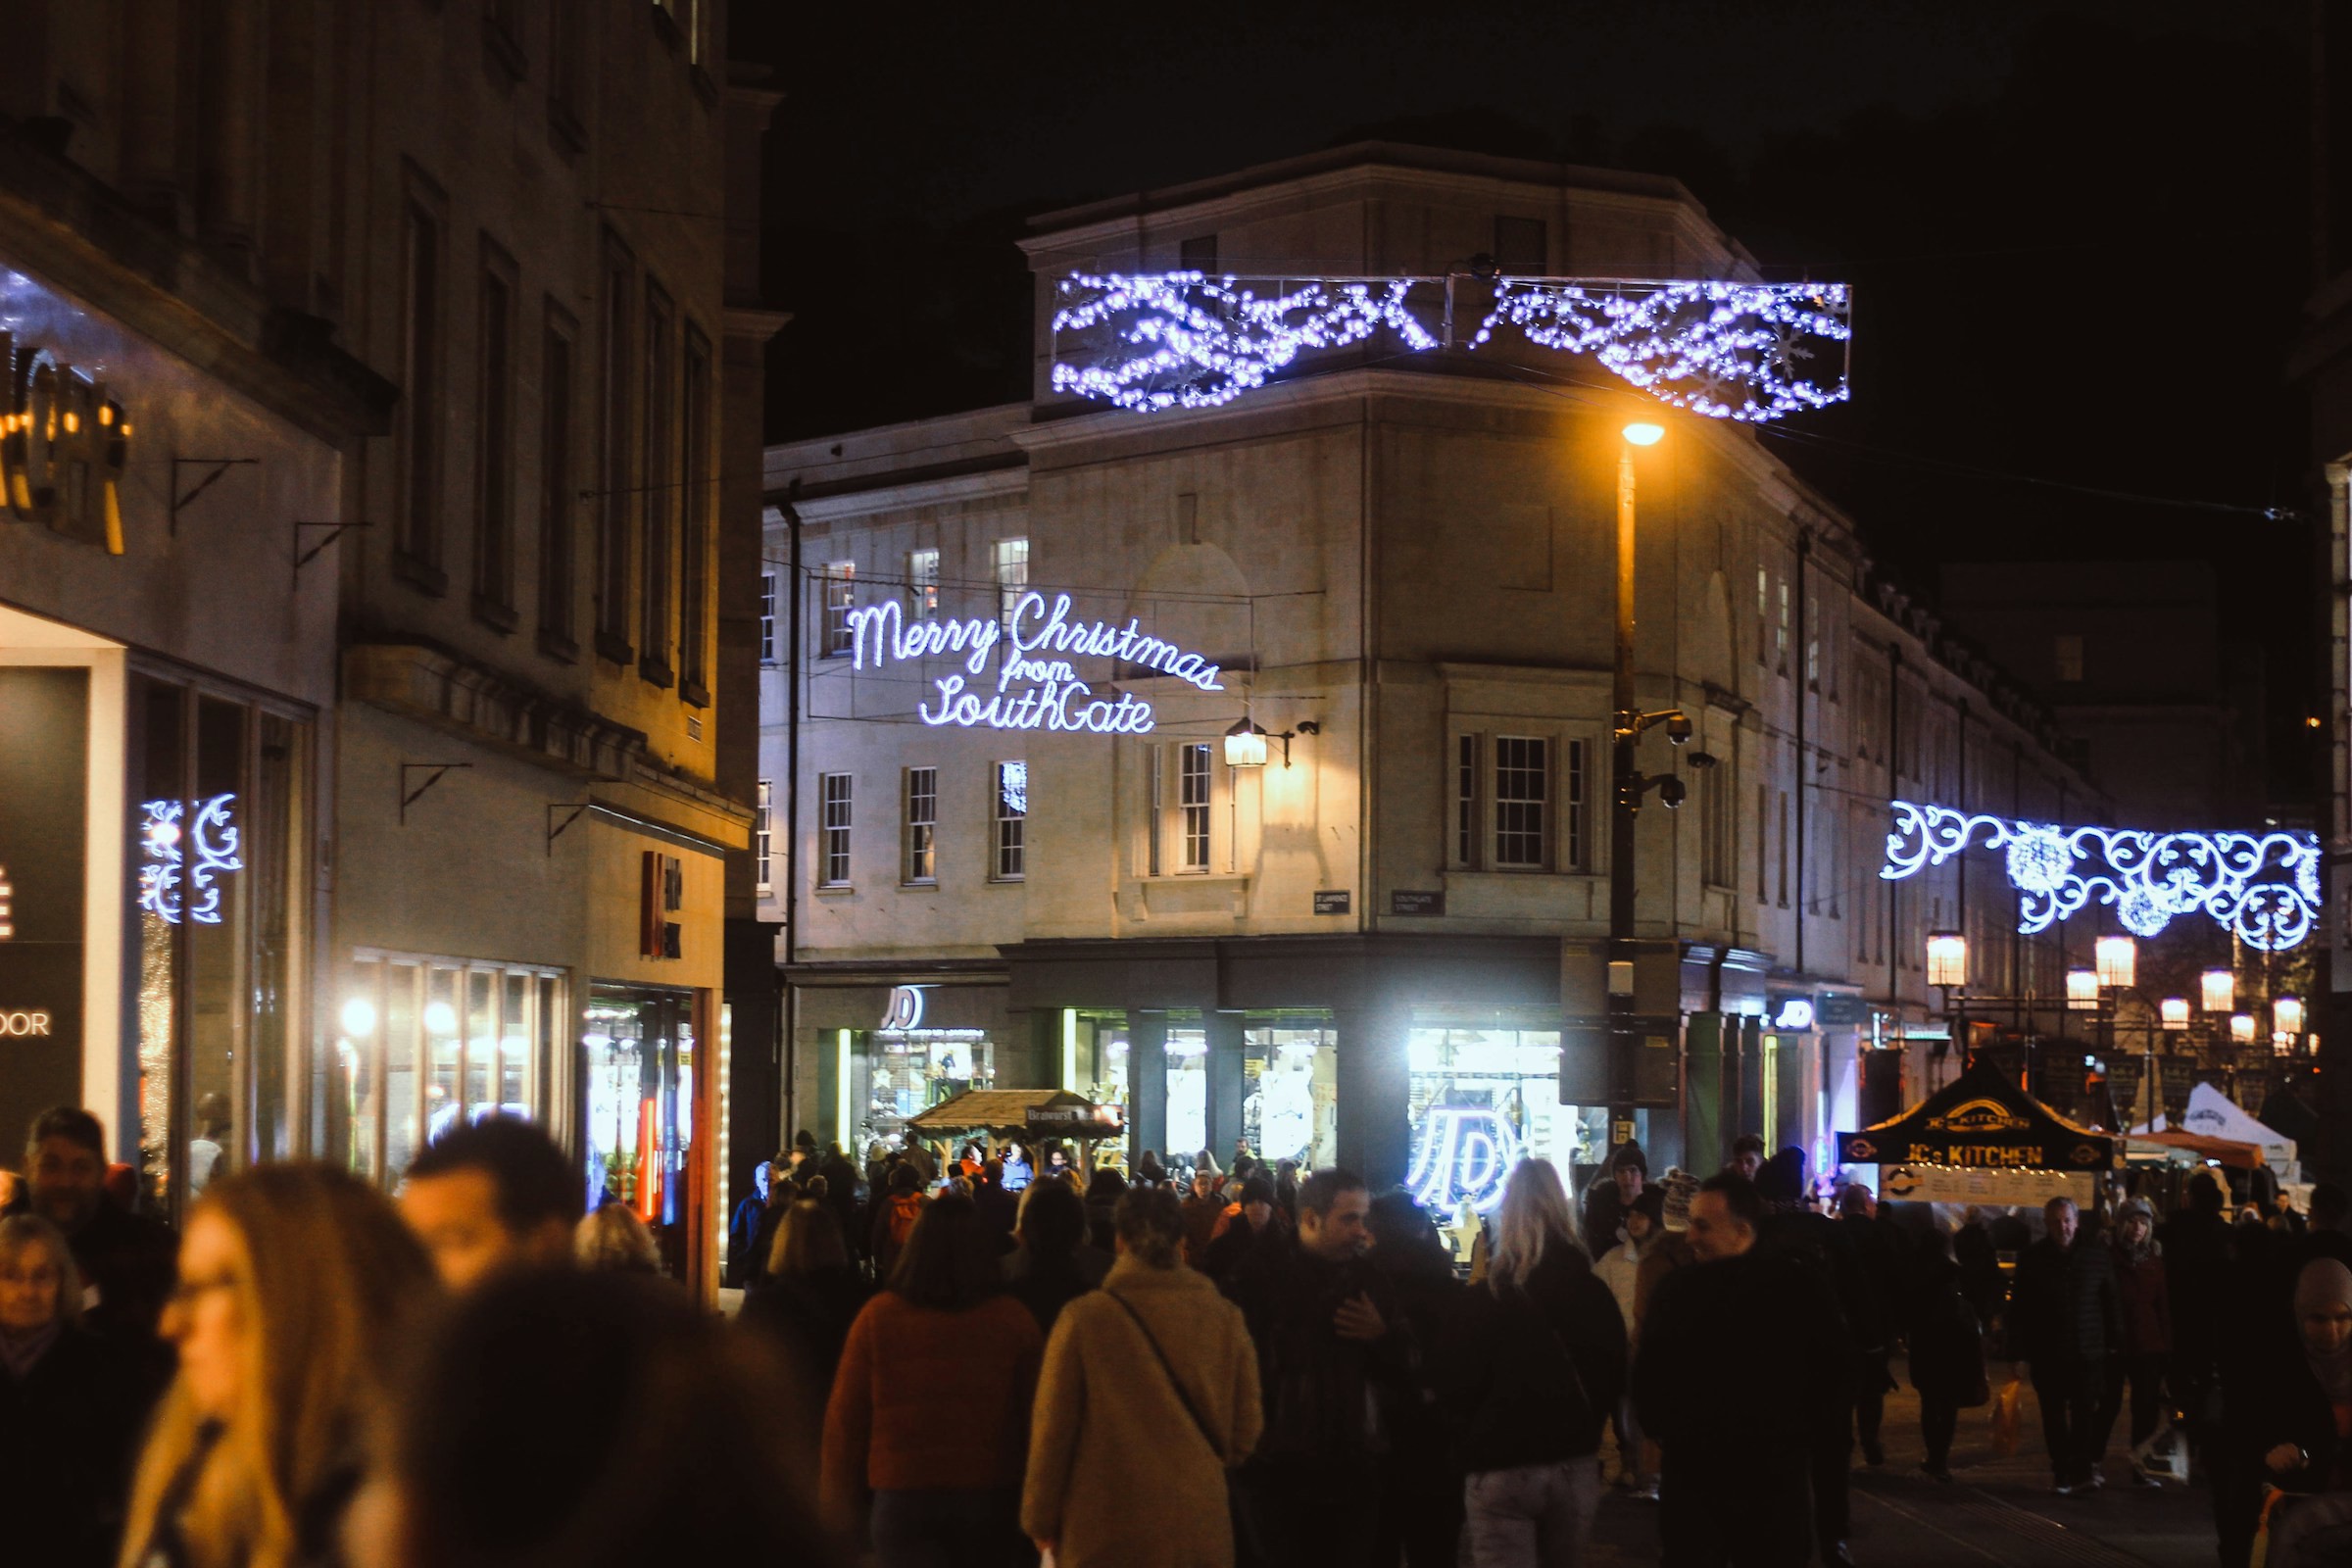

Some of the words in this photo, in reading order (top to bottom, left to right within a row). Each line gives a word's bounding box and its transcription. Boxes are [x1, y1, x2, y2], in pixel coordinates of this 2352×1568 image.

[847, 600, 1000, 675] Merry
[1010, 592, 1225, 692] Christmas
[1000, 650, 1077, 693] from
[880, 985, 923, 1030] JD
[1775, 999, 1814, 1028] JD
[1960, 1114, 2032, 1129] KITCHEN
[1948, 1145, 2042, 1165] KITCHEN
